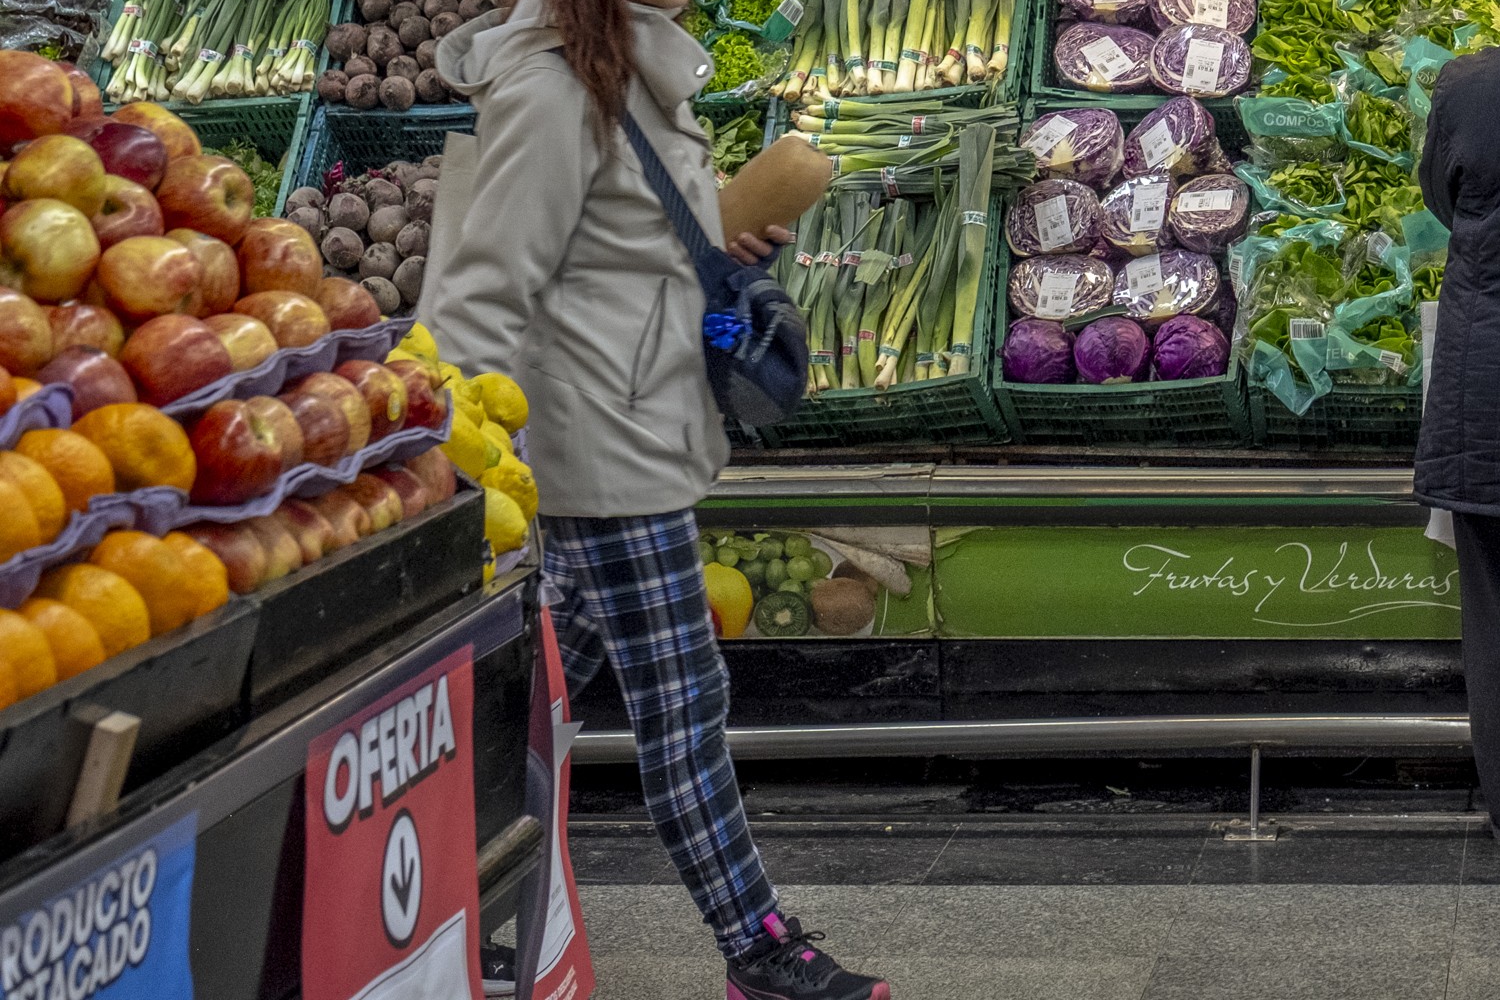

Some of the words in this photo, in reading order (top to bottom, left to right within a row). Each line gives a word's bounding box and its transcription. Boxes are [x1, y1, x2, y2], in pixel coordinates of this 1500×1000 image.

[1123, 544, 1258, 596] Frutas
[1253, 575, 1286, 613] y
[1275, 540, 1460, 596] Verduras
[323, 674, 457, 834] OFERTA
[0, 849, 157, 991] RODUCTO
